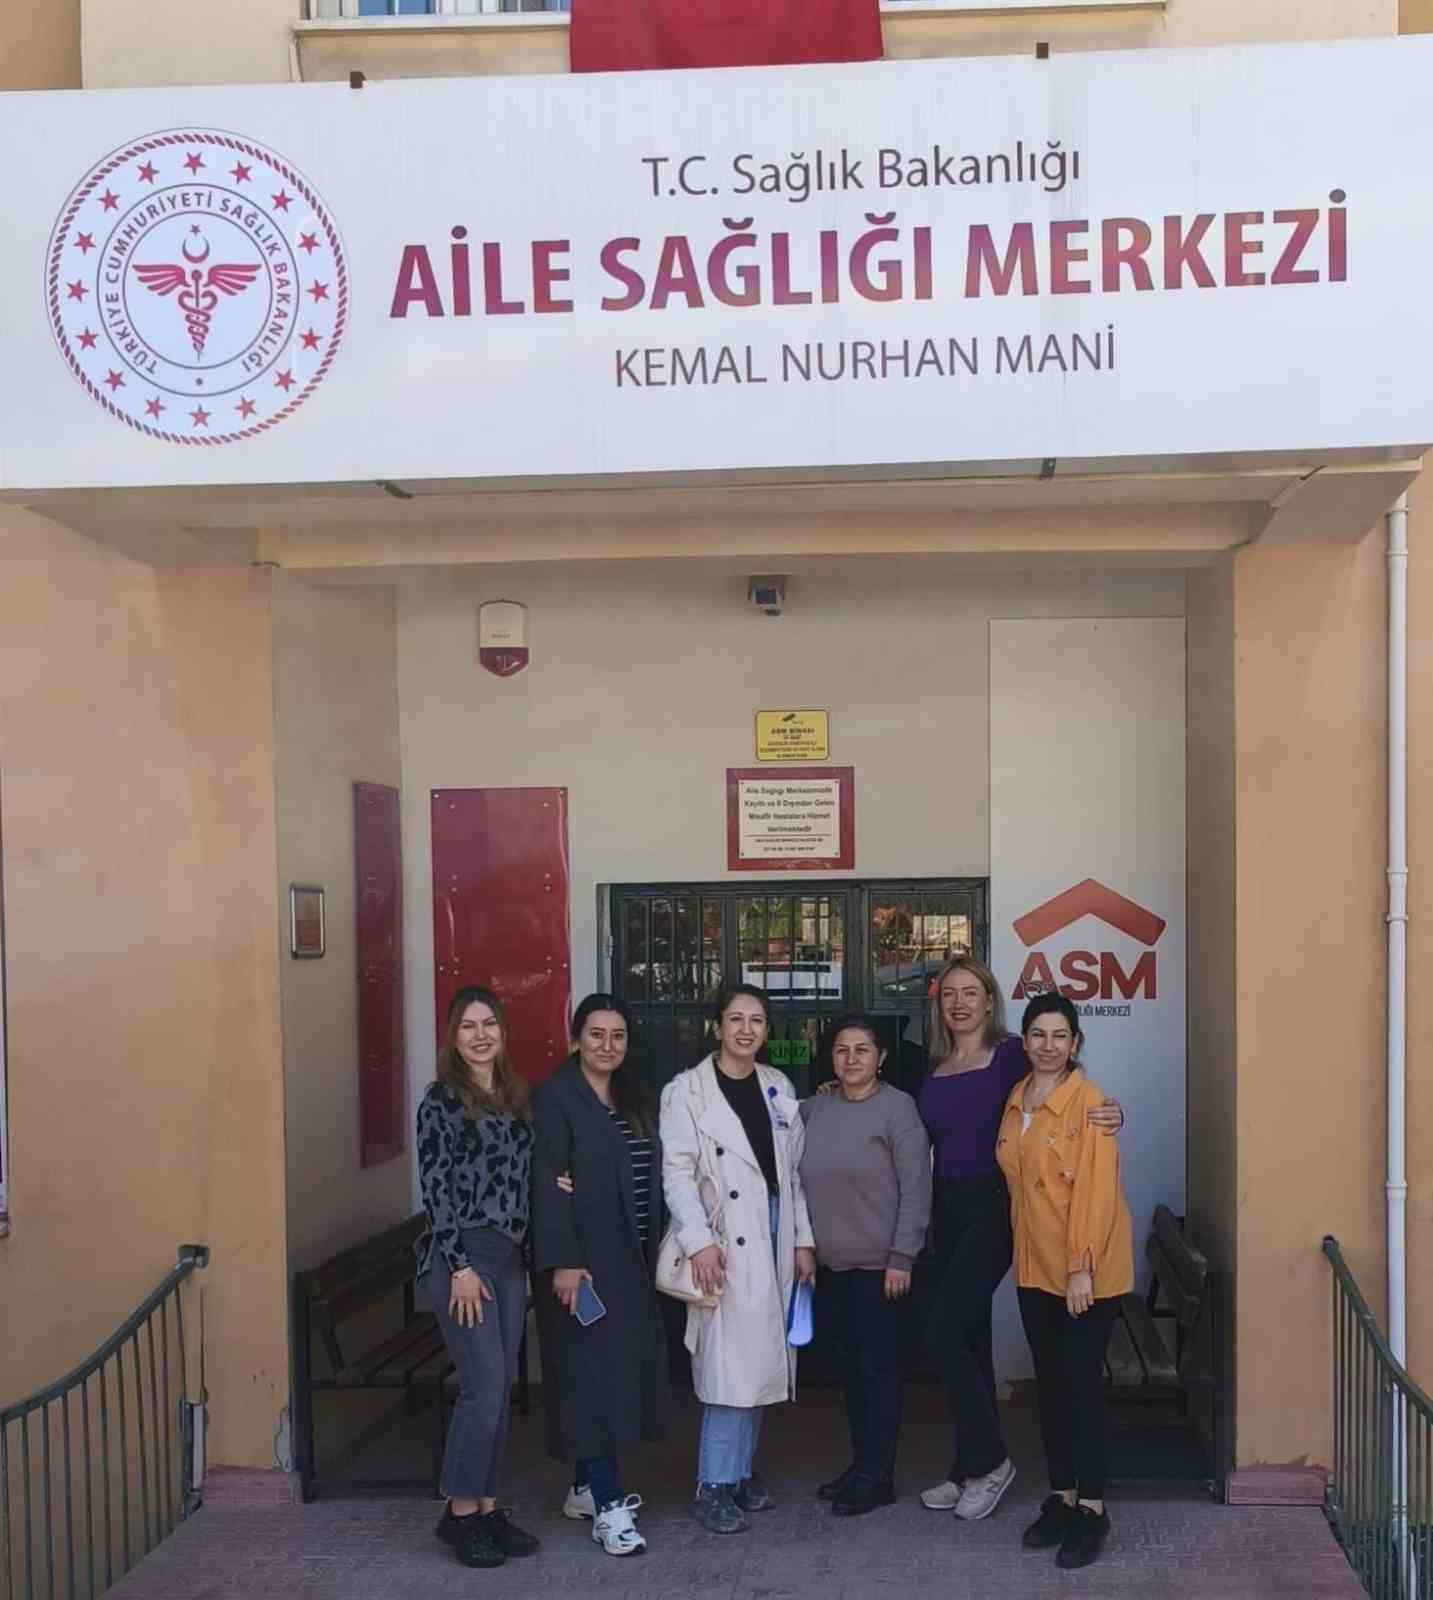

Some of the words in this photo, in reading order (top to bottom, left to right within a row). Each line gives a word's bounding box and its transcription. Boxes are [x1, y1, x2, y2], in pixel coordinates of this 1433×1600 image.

[642, 156, 718, 196] T.C.
[733, 149, 864, 202] Sağlık
[878, 141, 1080, 192] Bakanlığı
[106, 190, 213, 284] CUMHURİYETİ
[219, 198, 281, 257] SAĞLIK
[390, 225, 574, 318] AİLE
[600, 212, 932, 311] SAĞLIĞI
[964, 188, 1347, 298] MERKEZİ
[106, 292, 157, 374] TÜRKİYE
[242, 262, 291, 372] BAKANLIĞI
[615, 345, 767, 387] KEMAL
[782, 337, 978, 382] NURHAN
[996, 323, 1114, 374] MANİ
[1011, 950, 1157, 1000] ASM
[1095, 1003, 1131, 1016] MERKEZİ
